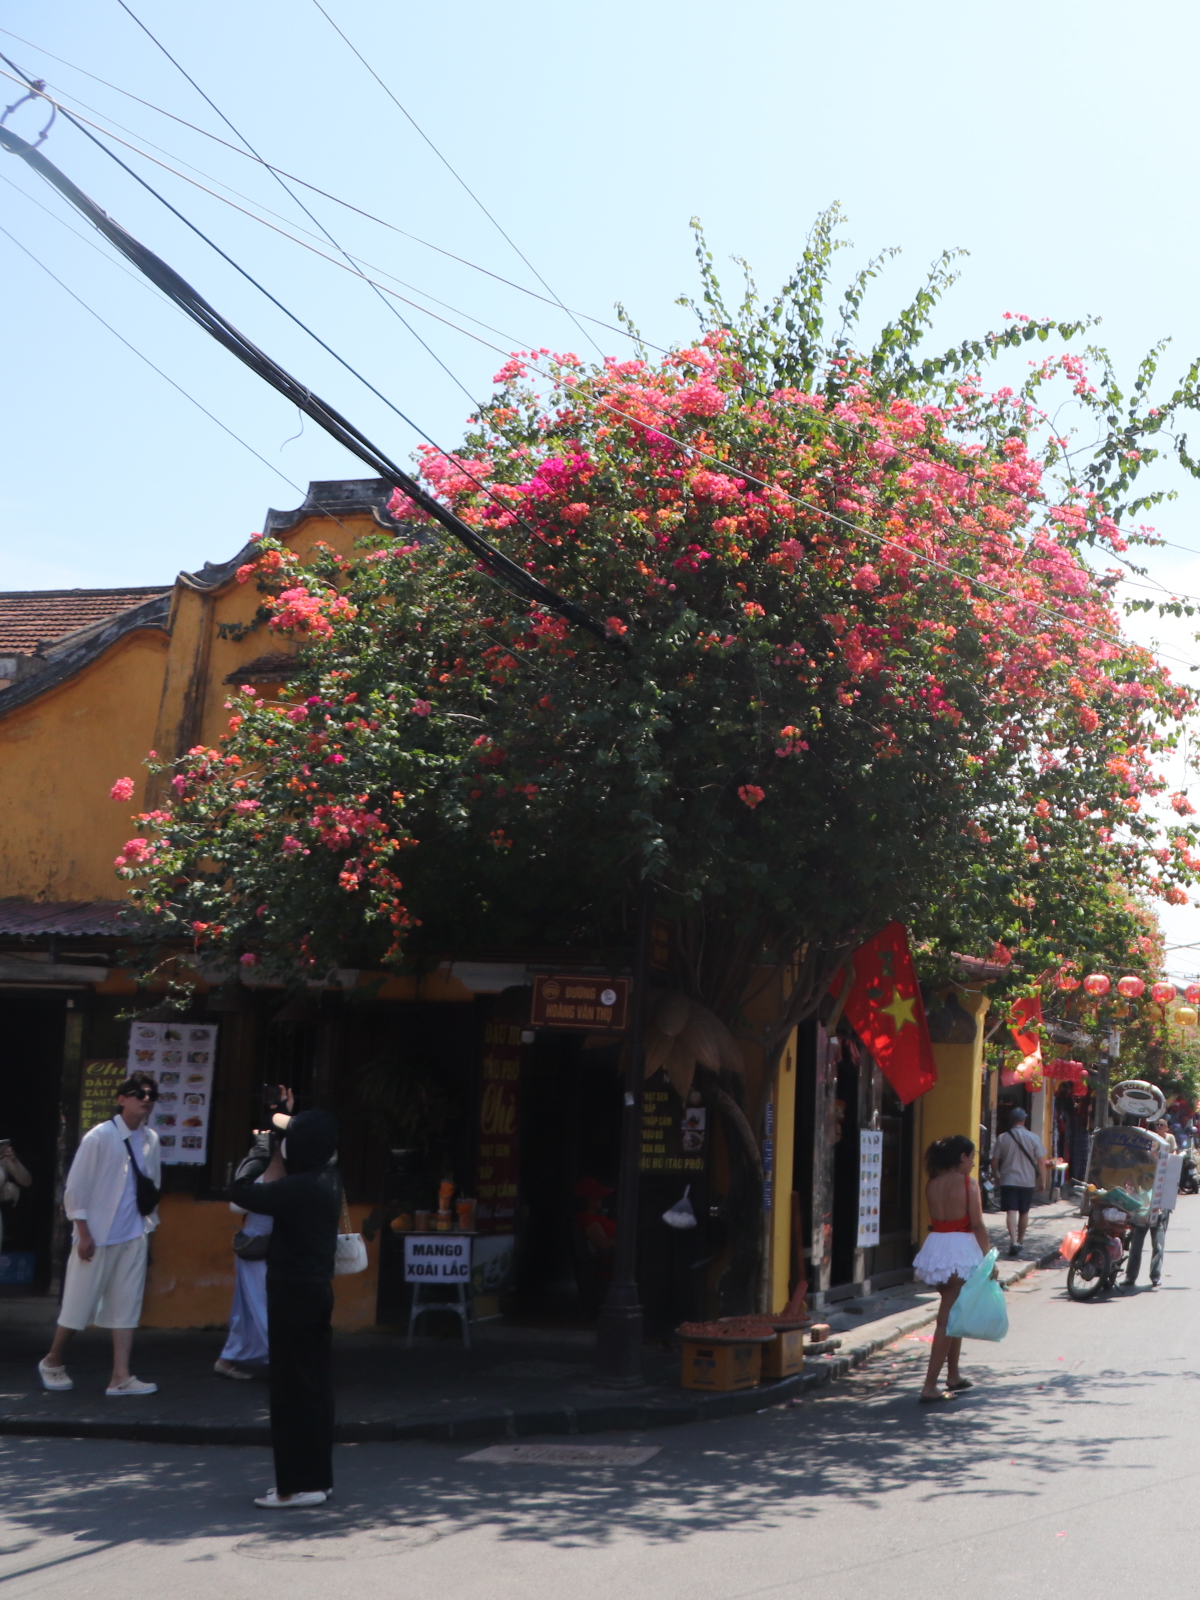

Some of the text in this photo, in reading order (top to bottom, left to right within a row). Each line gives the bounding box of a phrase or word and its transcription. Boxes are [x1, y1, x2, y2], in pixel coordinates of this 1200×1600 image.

[565, 984, 597, 1000] ĐƯỜNG
[545, 1002, 613, 1023] HOÀNG VĂN THỤ
[481, 1083, 518, 1135] Chè
[413, 1244, 463, 1256] MANGO
